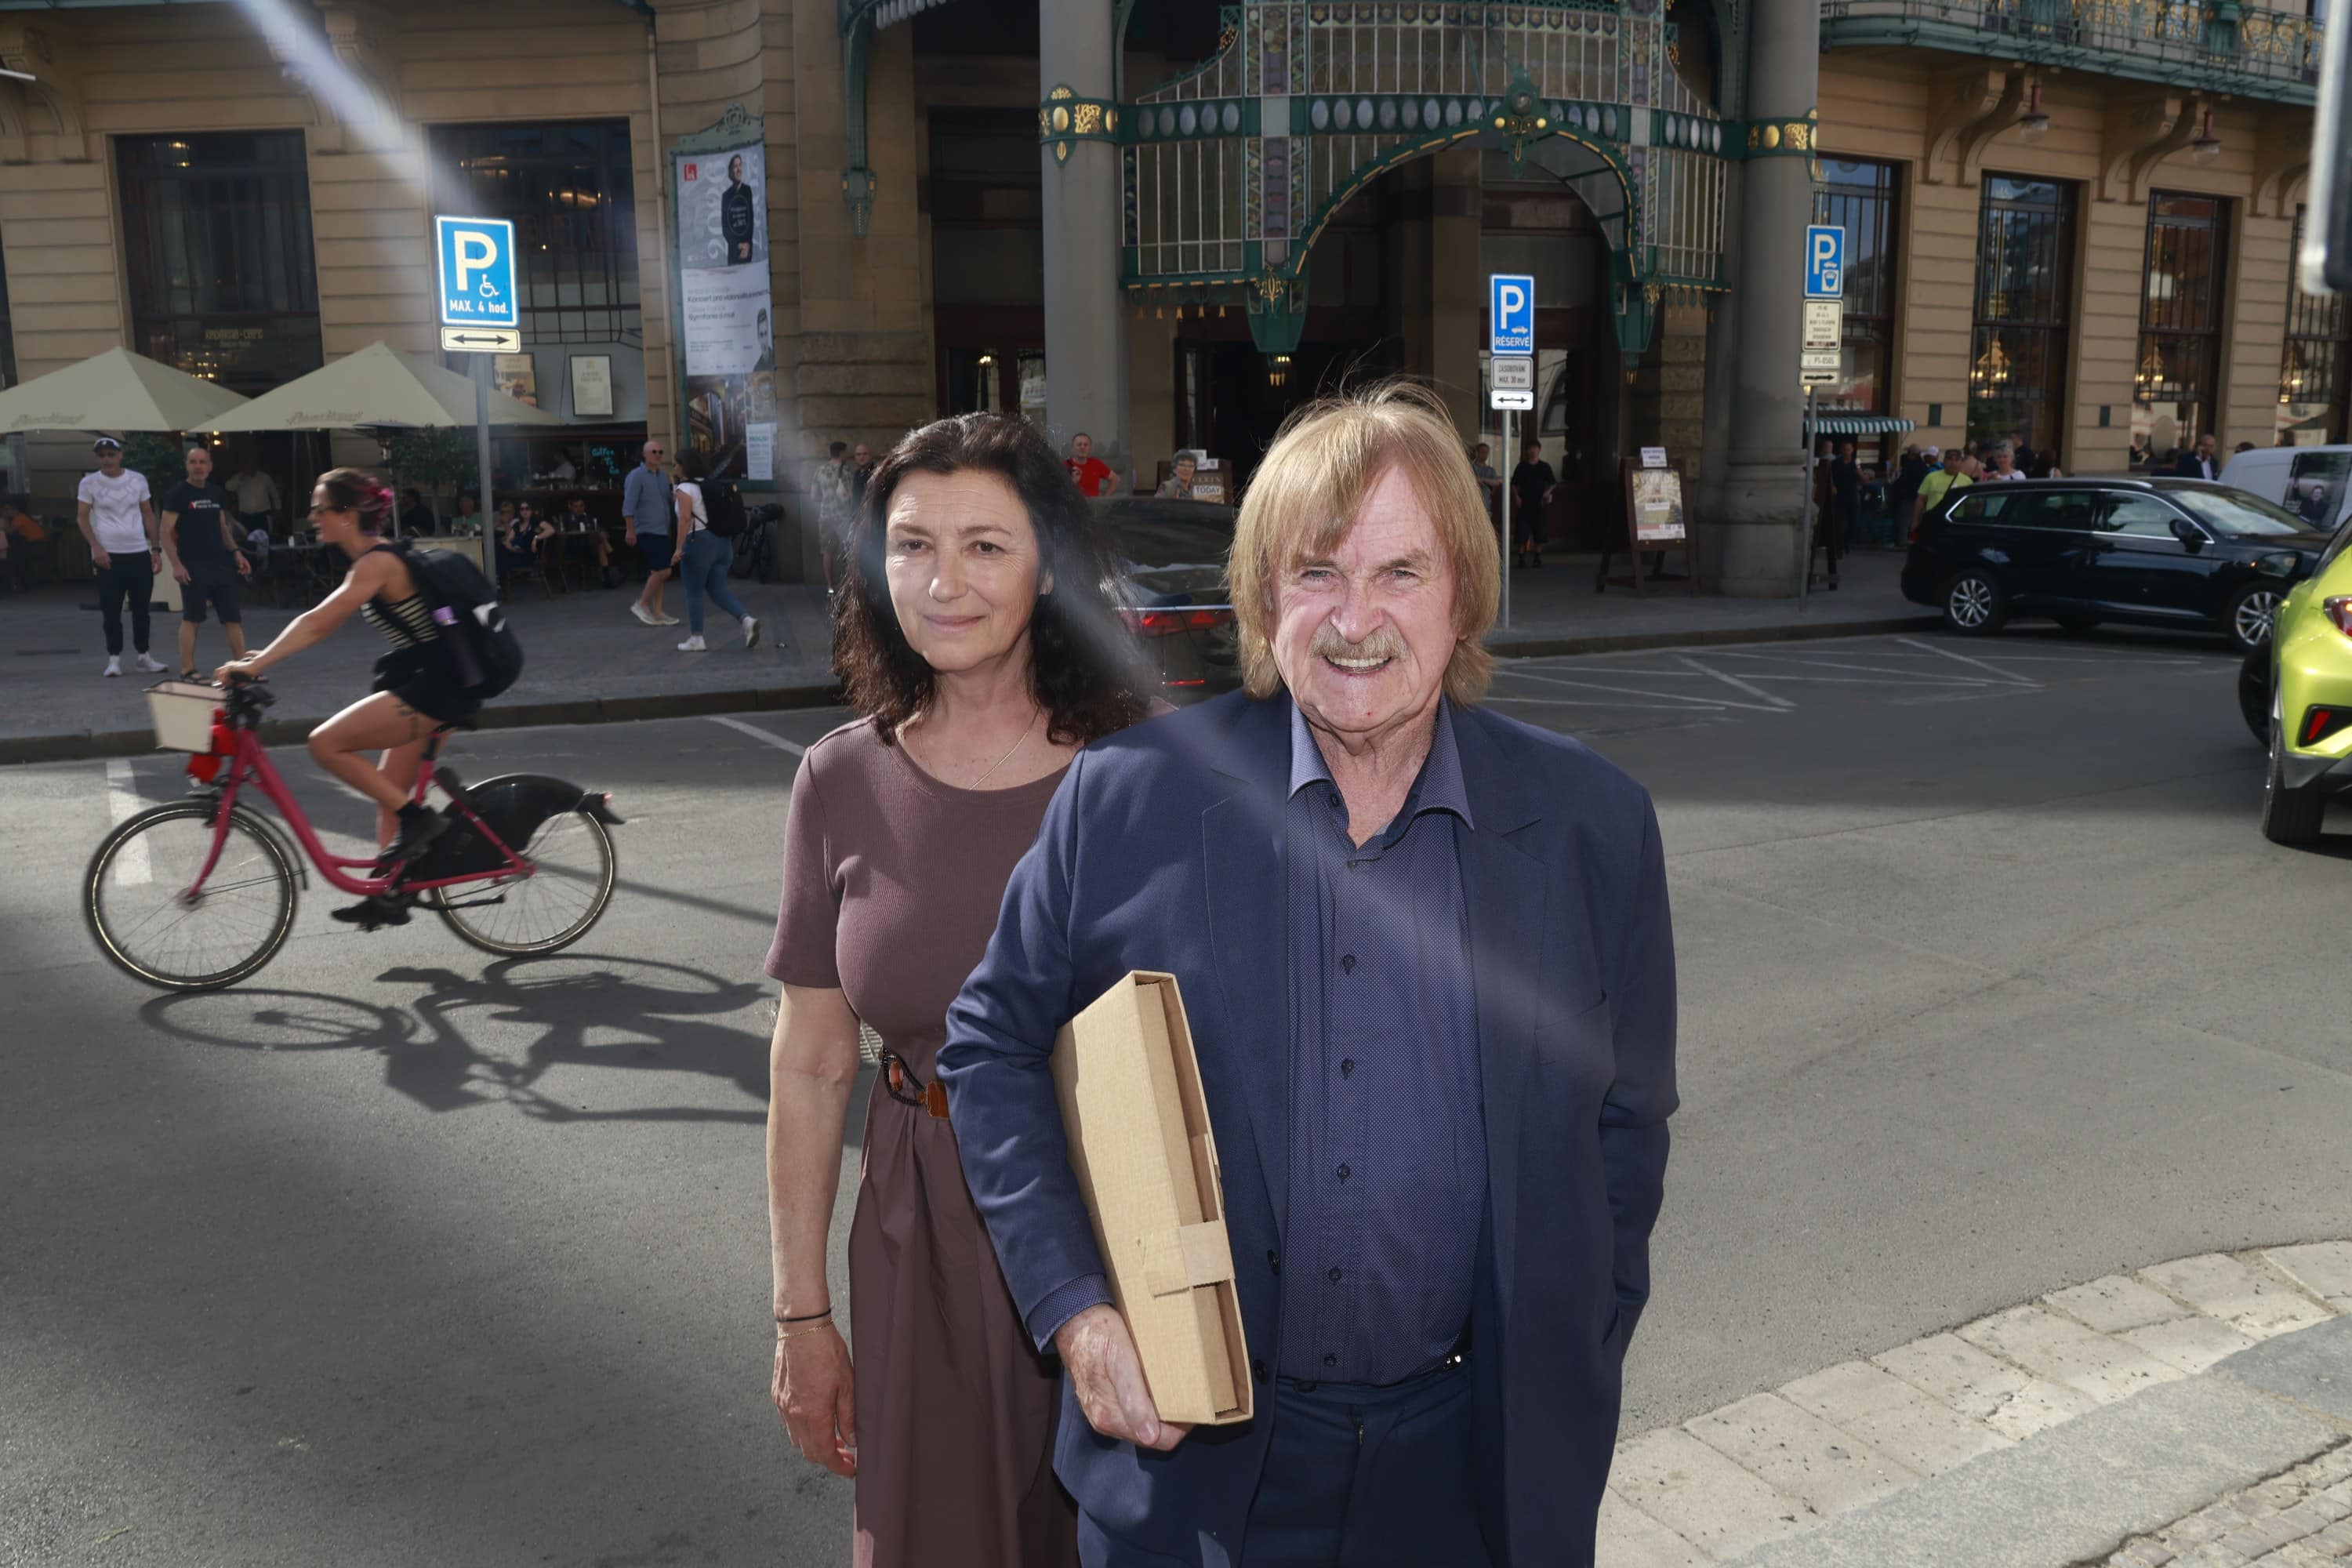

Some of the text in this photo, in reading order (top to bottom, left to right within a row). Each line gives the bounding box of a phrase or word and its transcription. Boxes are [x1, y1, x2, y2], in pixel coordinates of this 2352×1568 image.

[454, 230, 498, 291] P
[1813, 234, 1836, 274] P
[449, 299, 509, 314] MAX. 4 hod.
[1501, 285, 1525, 330] P
[1495, 335, 1530, 347] RÉSERVÉ
